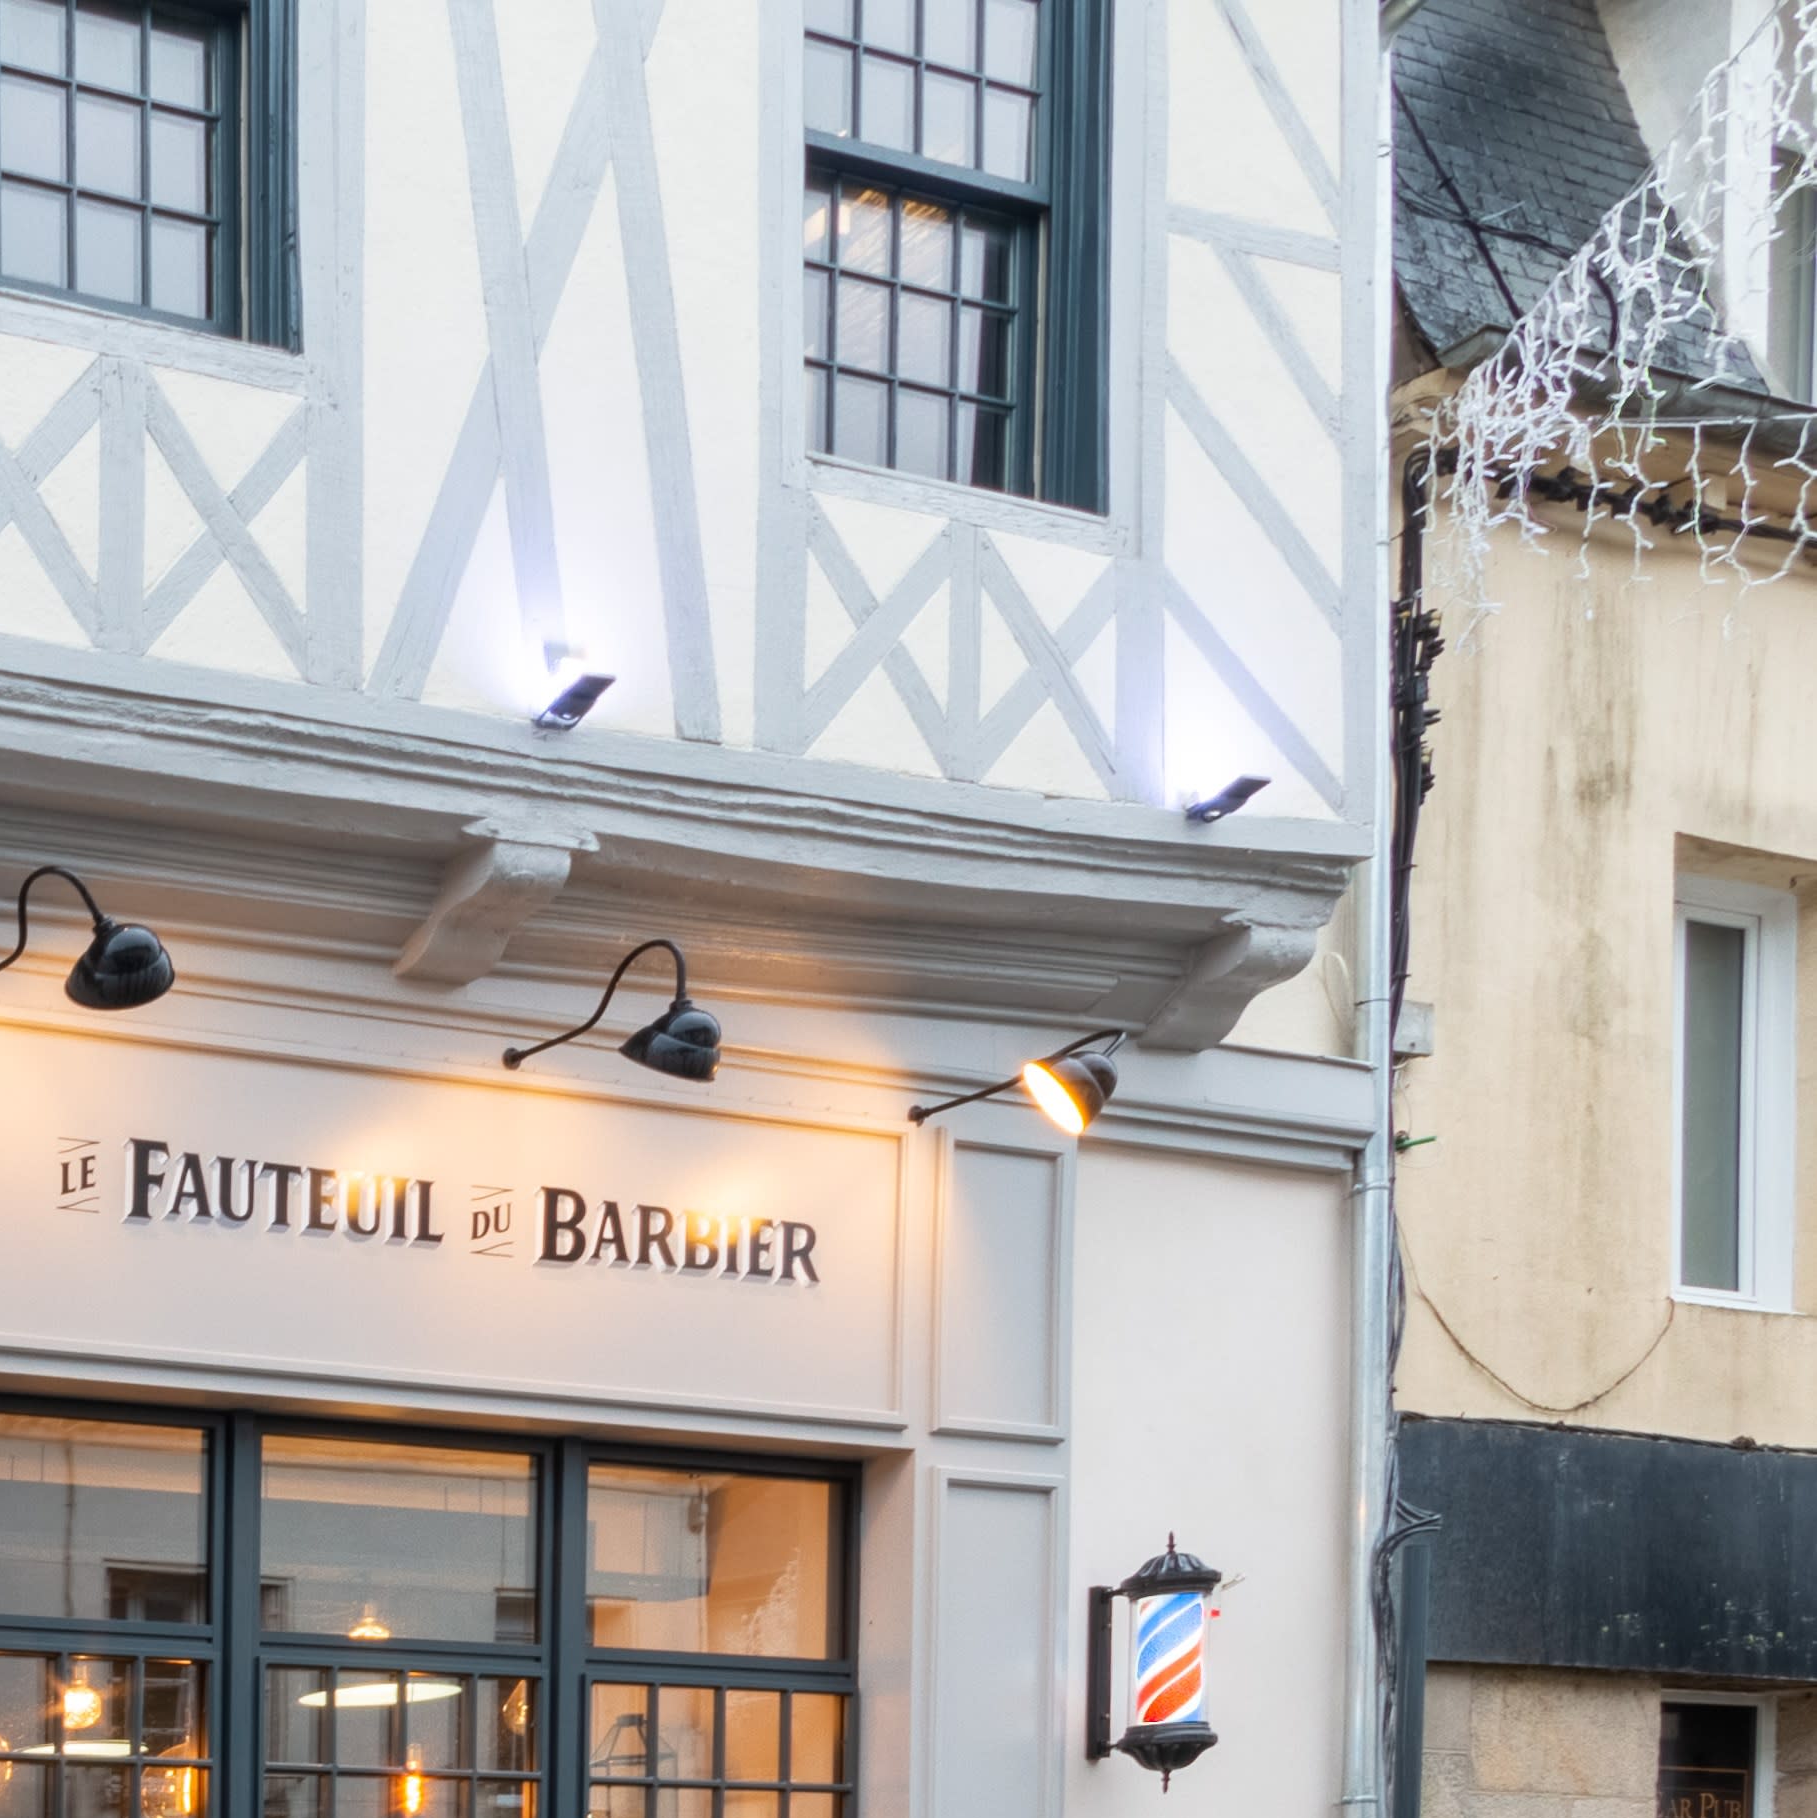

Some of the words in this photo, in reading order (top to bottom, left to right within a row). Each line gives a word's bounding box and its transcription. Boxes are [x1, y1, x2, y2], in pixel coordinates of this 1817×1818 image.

[59, 1153, 97, 1195] LE
[124, 1137, 444, 1247] FAUTEUIL
[471, 1202, 512, 1241] DU
[535, 1185, 820, 1285] BARBIER
